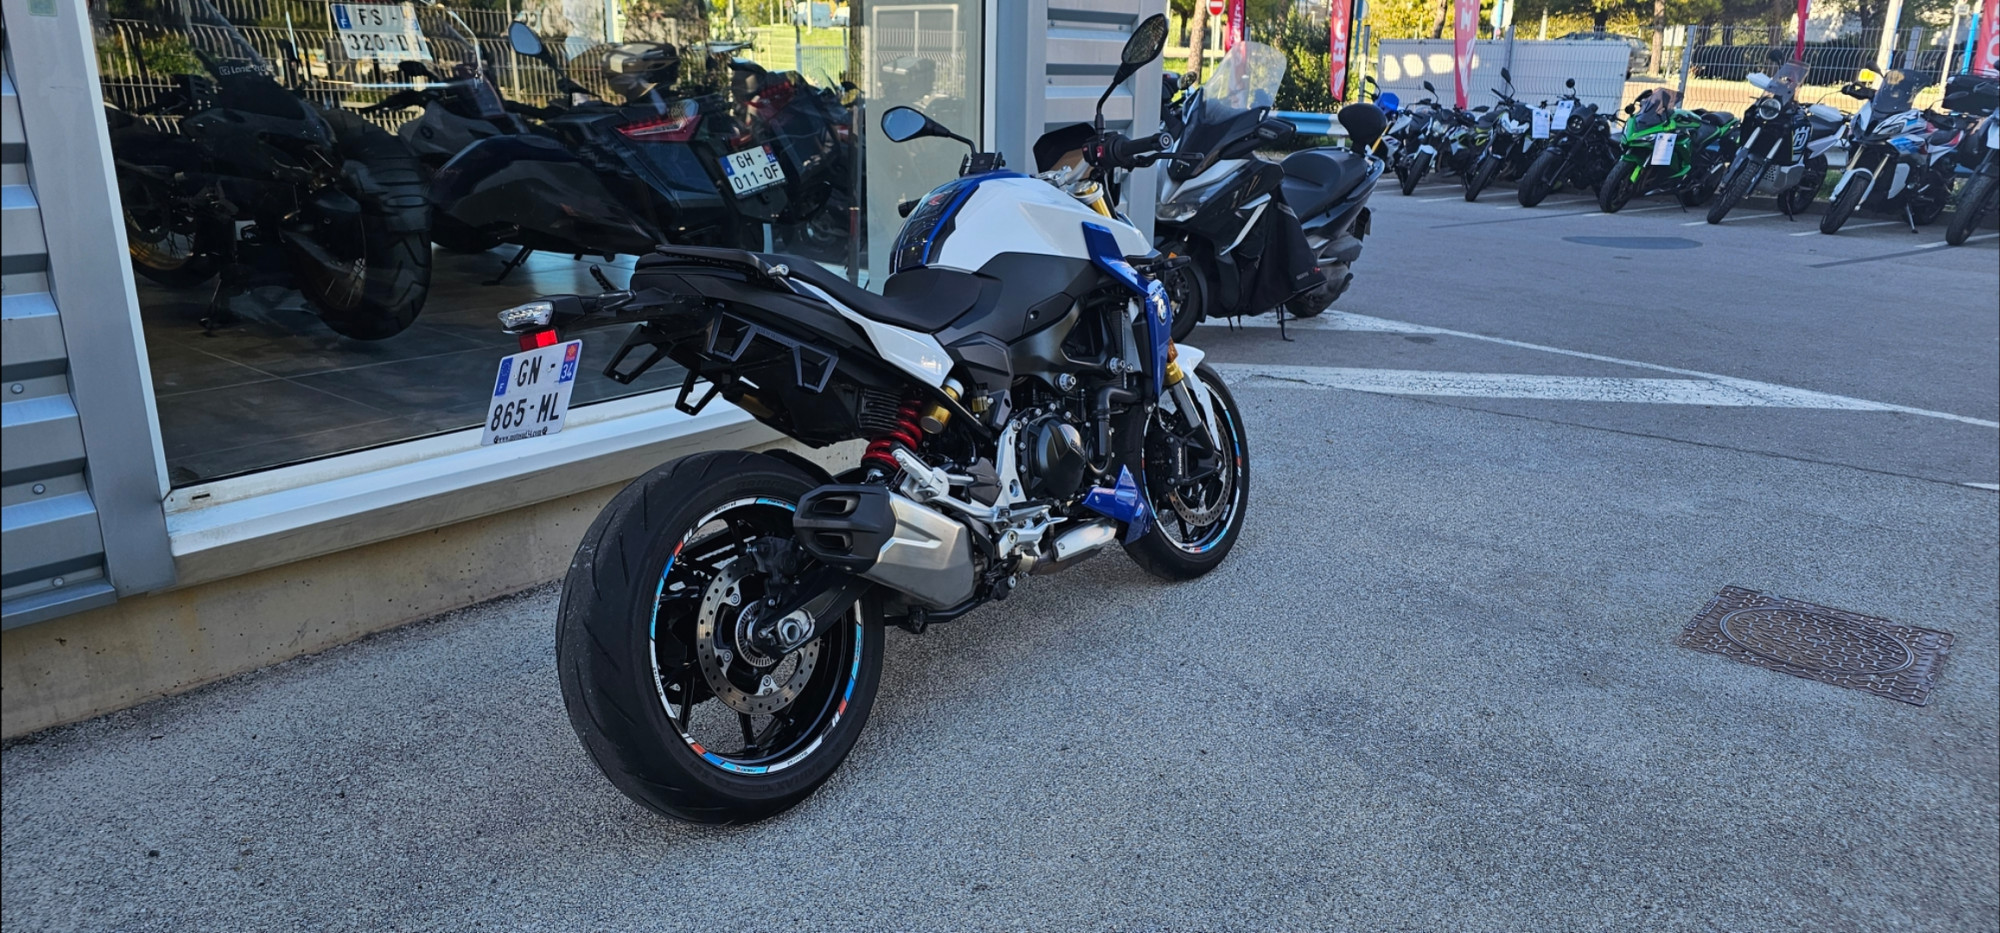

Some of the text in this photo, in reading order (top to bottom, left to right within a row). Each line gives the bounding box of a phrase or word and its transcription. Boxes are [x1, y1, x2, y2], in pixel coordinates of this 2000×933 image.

[358, 8, 383, 26] FS
[736, 152, 755, 169] GH
[517, 355, 543, 387] GN
[561, 362, 574, 380] 34
[490, 392, 560, 432] 865-ML
